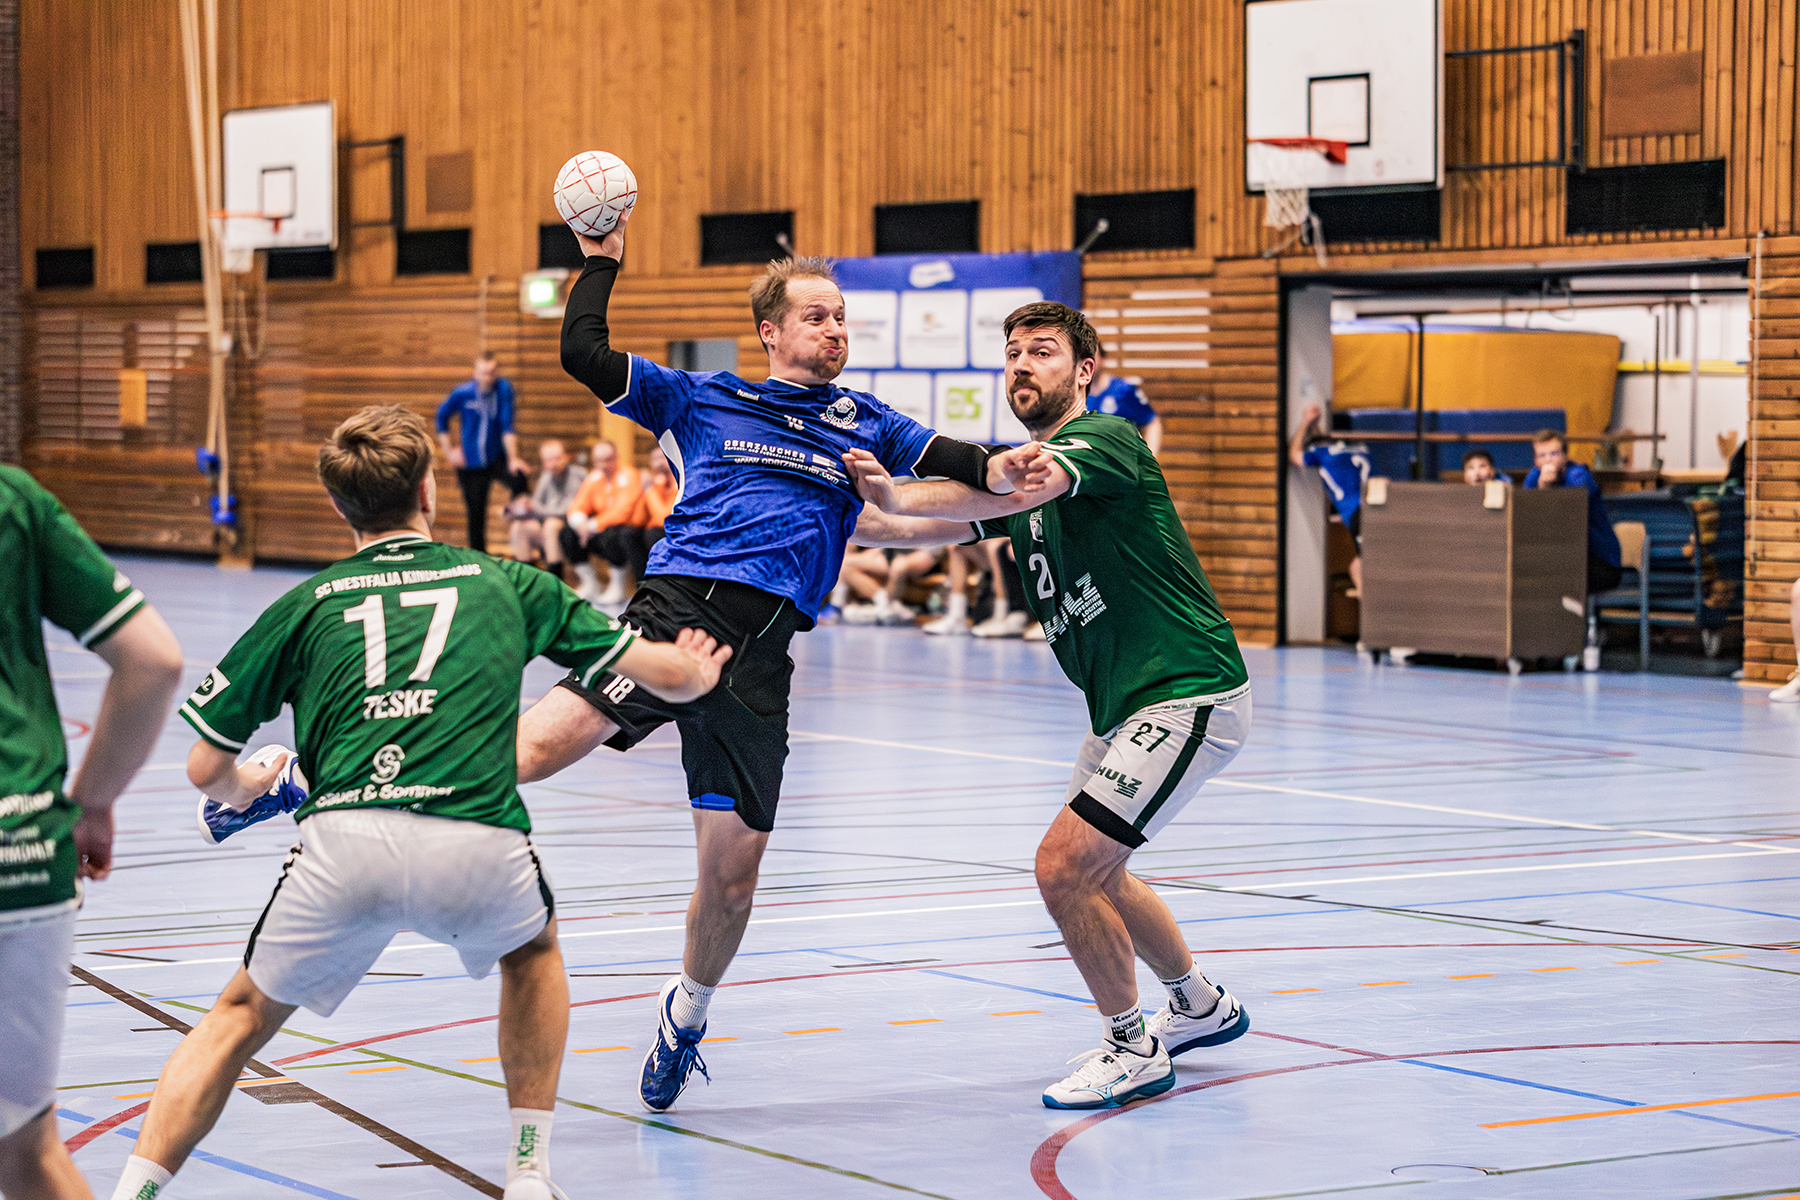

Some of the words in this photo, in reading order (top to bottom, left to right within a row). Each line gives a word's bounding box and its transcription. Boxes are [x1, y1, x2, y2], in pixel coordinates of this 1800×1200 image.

[724, 439, 806, 461] OBERZAUCHER
[314, 582, 332, 600] SC
[331, 571, 402, 593] WESTFALIA
[402, 563, 482, 585] KINDERHAUS
[343, 586, 459, 689] 17
[363, 689, 438, 720] TESKE
[602, 674, 636, 704] 18
[1130, 722, 1172, 753] 27
[362, 784, 377, 802] &
[378, 783, 456, 800] Sommer
